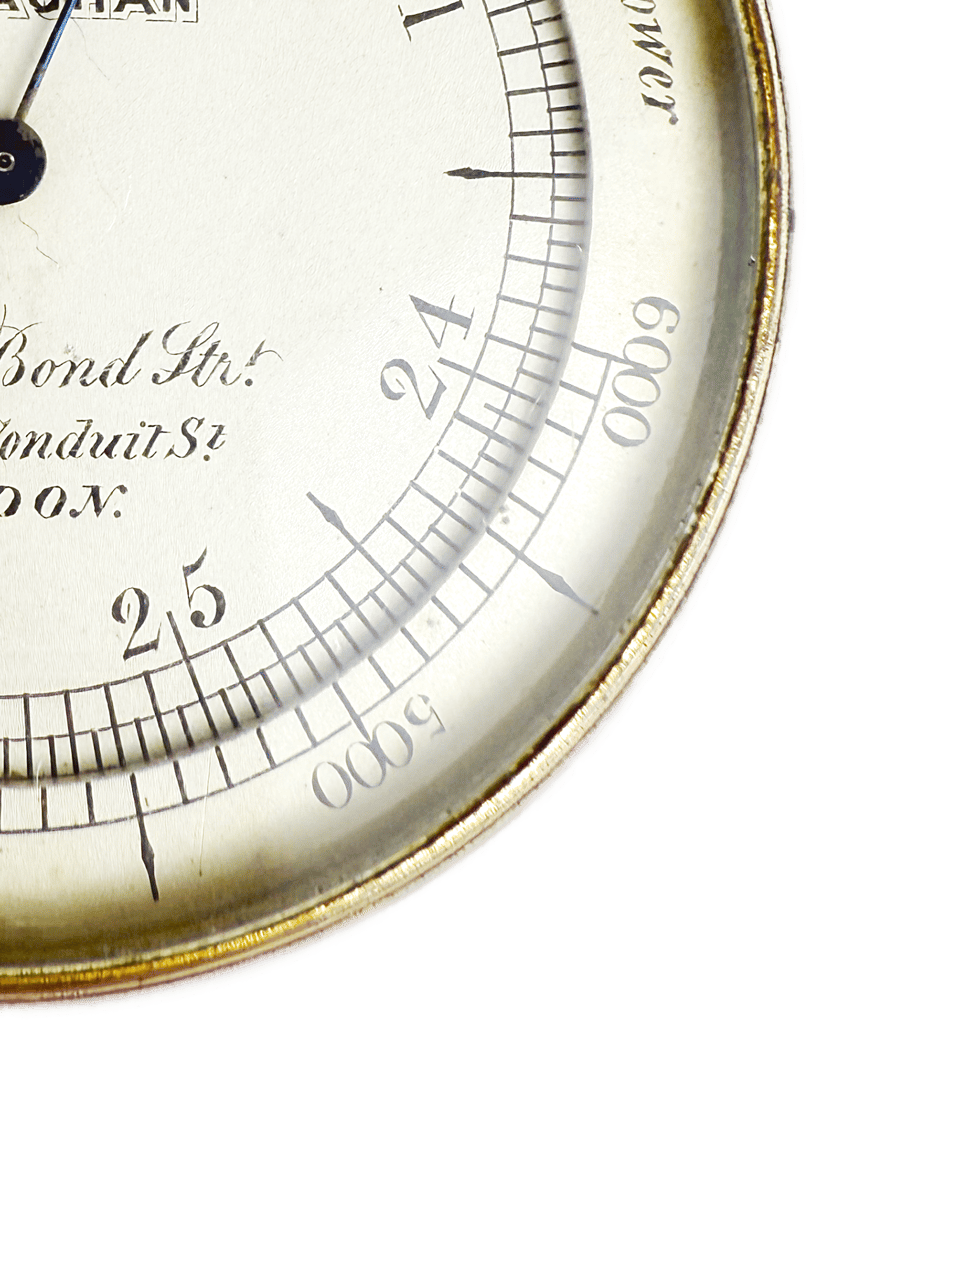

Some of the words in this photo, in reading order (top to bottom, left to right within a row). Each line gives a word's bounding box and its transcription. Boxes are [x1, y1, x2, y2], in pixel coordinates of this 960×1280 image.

[380, 294, 476, 420] 24
[601, 295, 681, 448] 6000
[111, 546, 227, 661] 25
[311, 692, 446, 811] 5000
